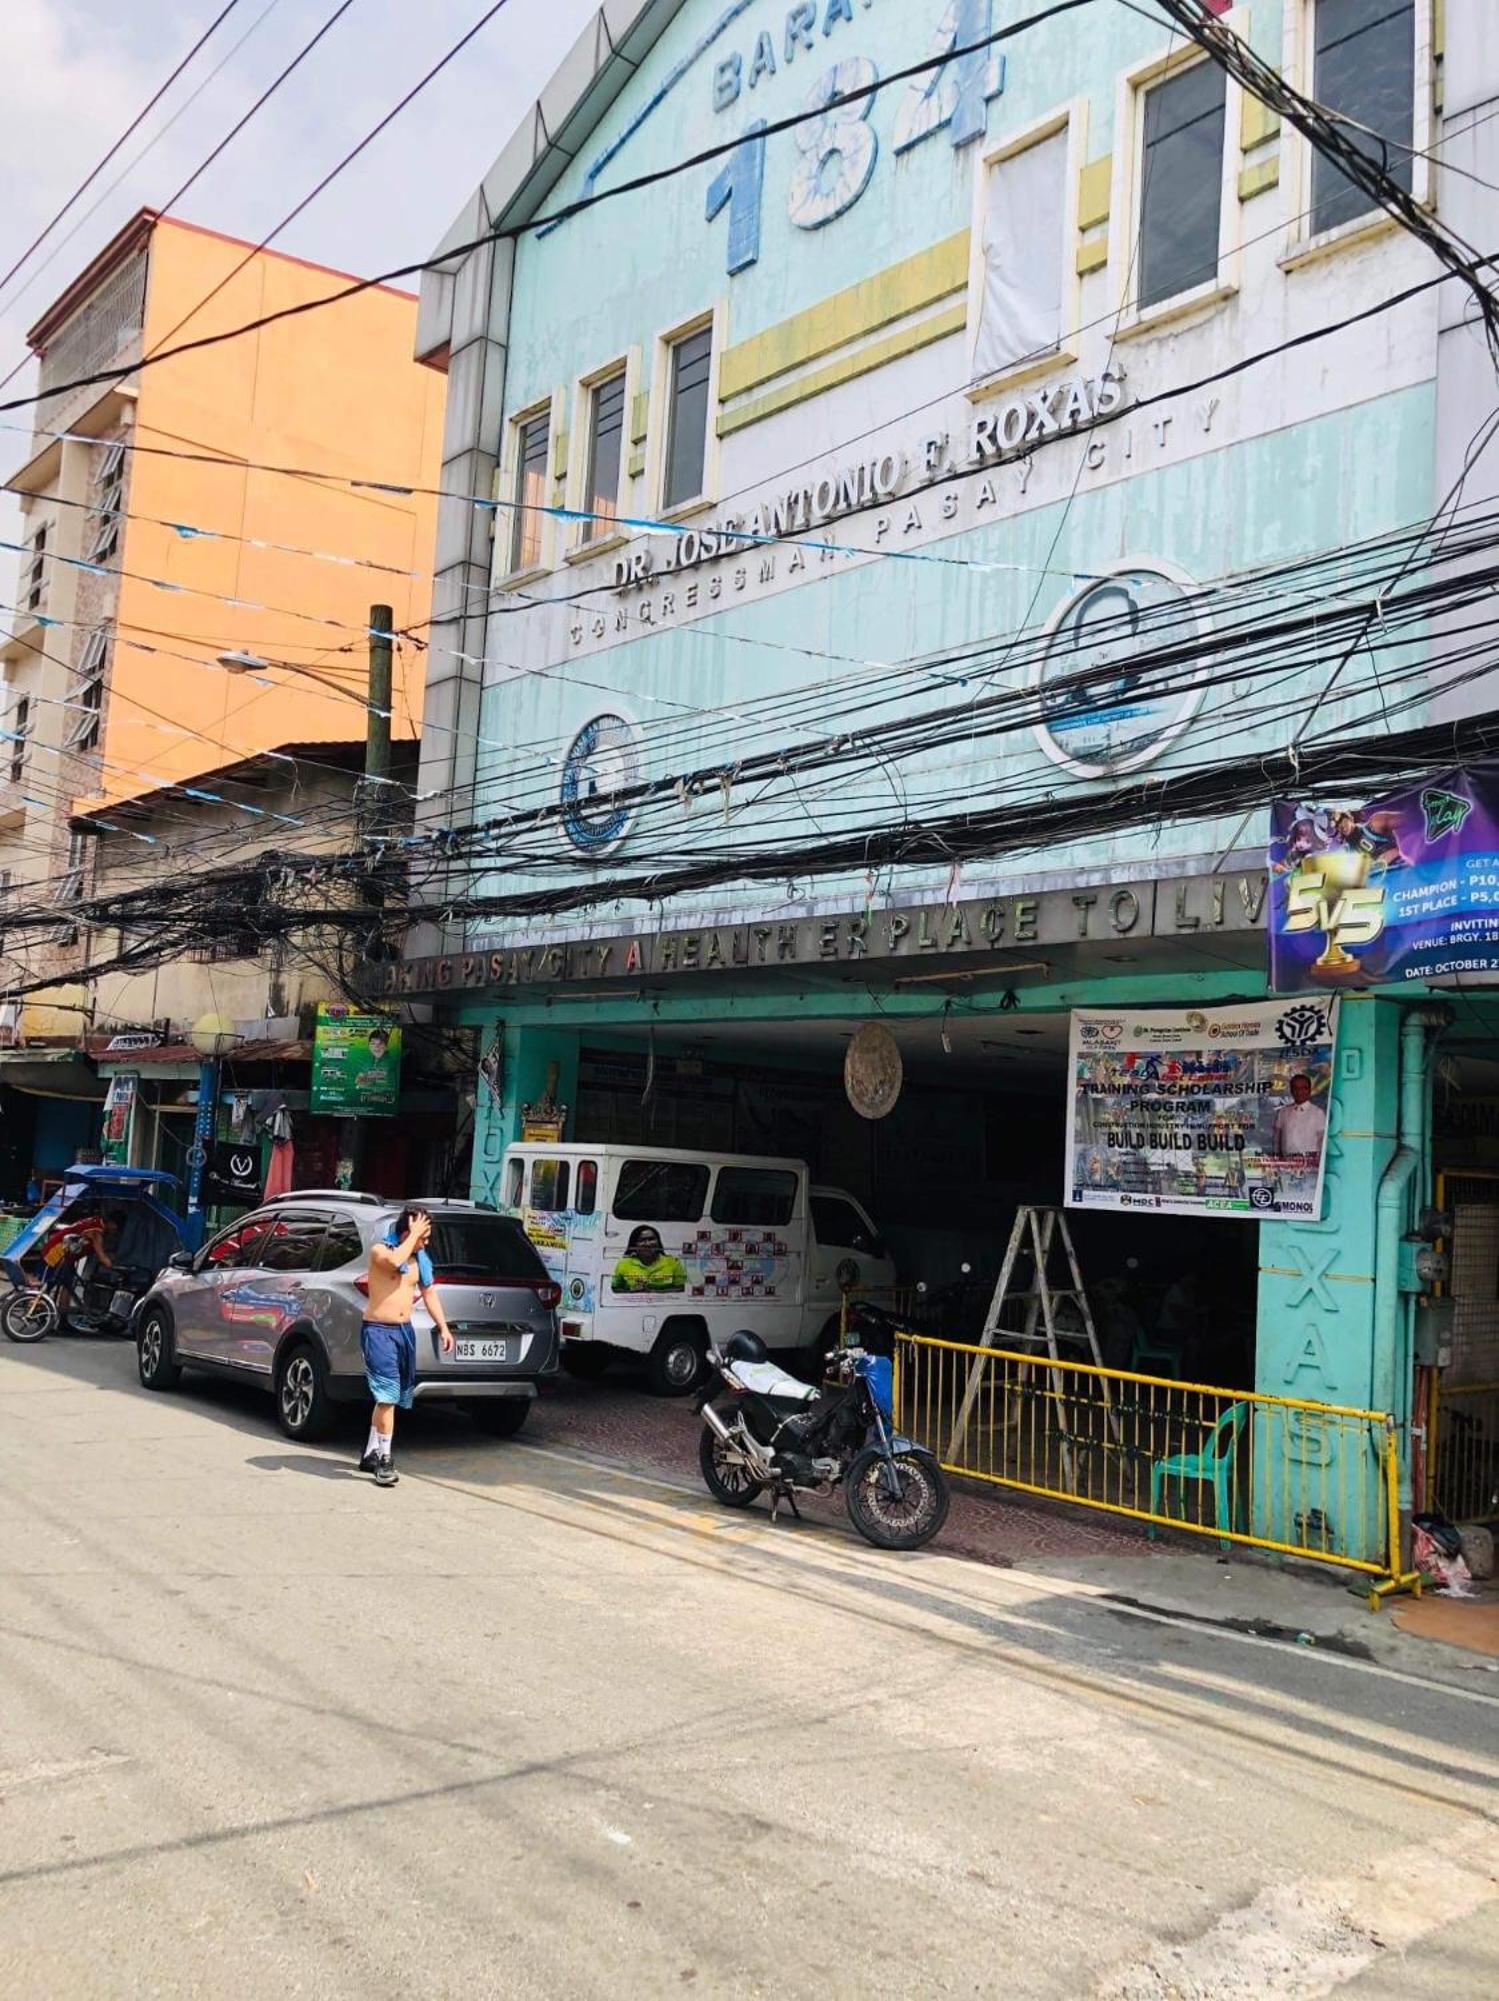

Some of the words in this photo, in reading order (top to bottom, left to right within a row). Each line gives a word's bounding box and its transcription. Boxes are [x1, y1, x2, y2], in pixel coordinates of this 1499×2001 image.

[712, 0, 873, 114] BARA
[705, 0, 1006, 277] 184
[749, 454, 899, 544] ANTONIO
[968, 366, 1127, 462] ROXAS
[875, 453, 1033, 544] PASAY
[1087, 397, 1221, 470] CITY
[1466, 858, 1488, 868] GET
[1393, 879, 1457, 902] CHAMPION
[1398, 906, 1419, 918] 1ST
[1422, 895, 1457, 912] PLACE
[462, 949, 533, 988] PASAY
[627, 940, 644, 973] A
[886, 899, 1039, 951] PLACE
[1072, 888, 1140, 936] TO
[1412, 936, 1448, 950] VENUE:
[1450, 932, 1483, 944] BRGY.
[1405, 965, 1434, 979] DATE:
[1435, 958, 1488, 973] OCTOBER
[1081, 1083, 1150, 1095] TRAINING
[1158, 1081, 1272, 1096] SCHOLARSHIP
[1130, 1101, 1211, 1112] PROGRAM
[1107, 1132, 1145, 1148] BUILD
[1150, 1133, 1192, 1149] BUILD
[1198, 1133, 1245, 1151] BUILD
[457, 1344, 475, 1356] NBS
[481, 1344, 505, 1357] 6672
